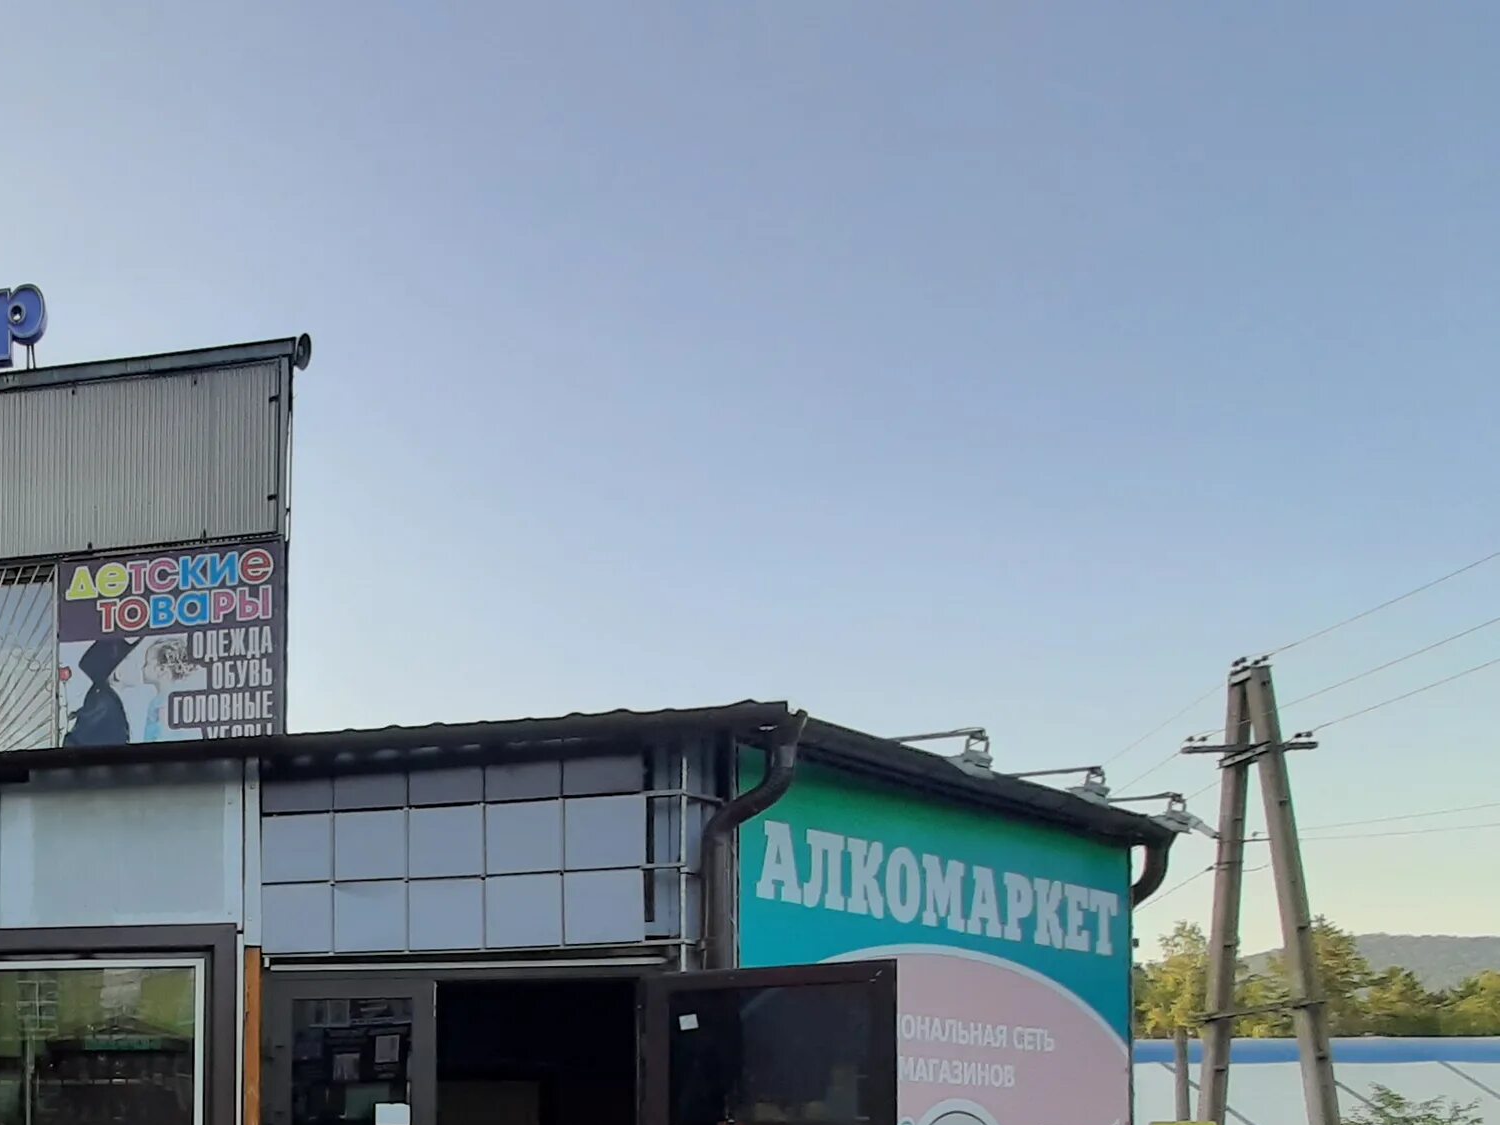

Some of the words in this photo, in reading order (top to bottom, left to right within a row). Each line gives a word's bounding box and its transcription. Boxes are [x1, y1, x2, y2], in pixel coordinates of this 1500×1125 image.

[193, 626, 273, 662] ОДЕЖДА
[212, 658, 273, 690] ОБУВЬ
[173, 690, 273, 724] ГОЛОВНЫЕ
[756, 820, 1119, 956] АЛКОМАРКЕТ
[897, 1013, 1007, 1048] ОНАЛЬНАЯ
[1012, 1026, 1055, 1051] СЕТЬ
[898, 1055, 1015, 1088] МАГАЗИНОВ
